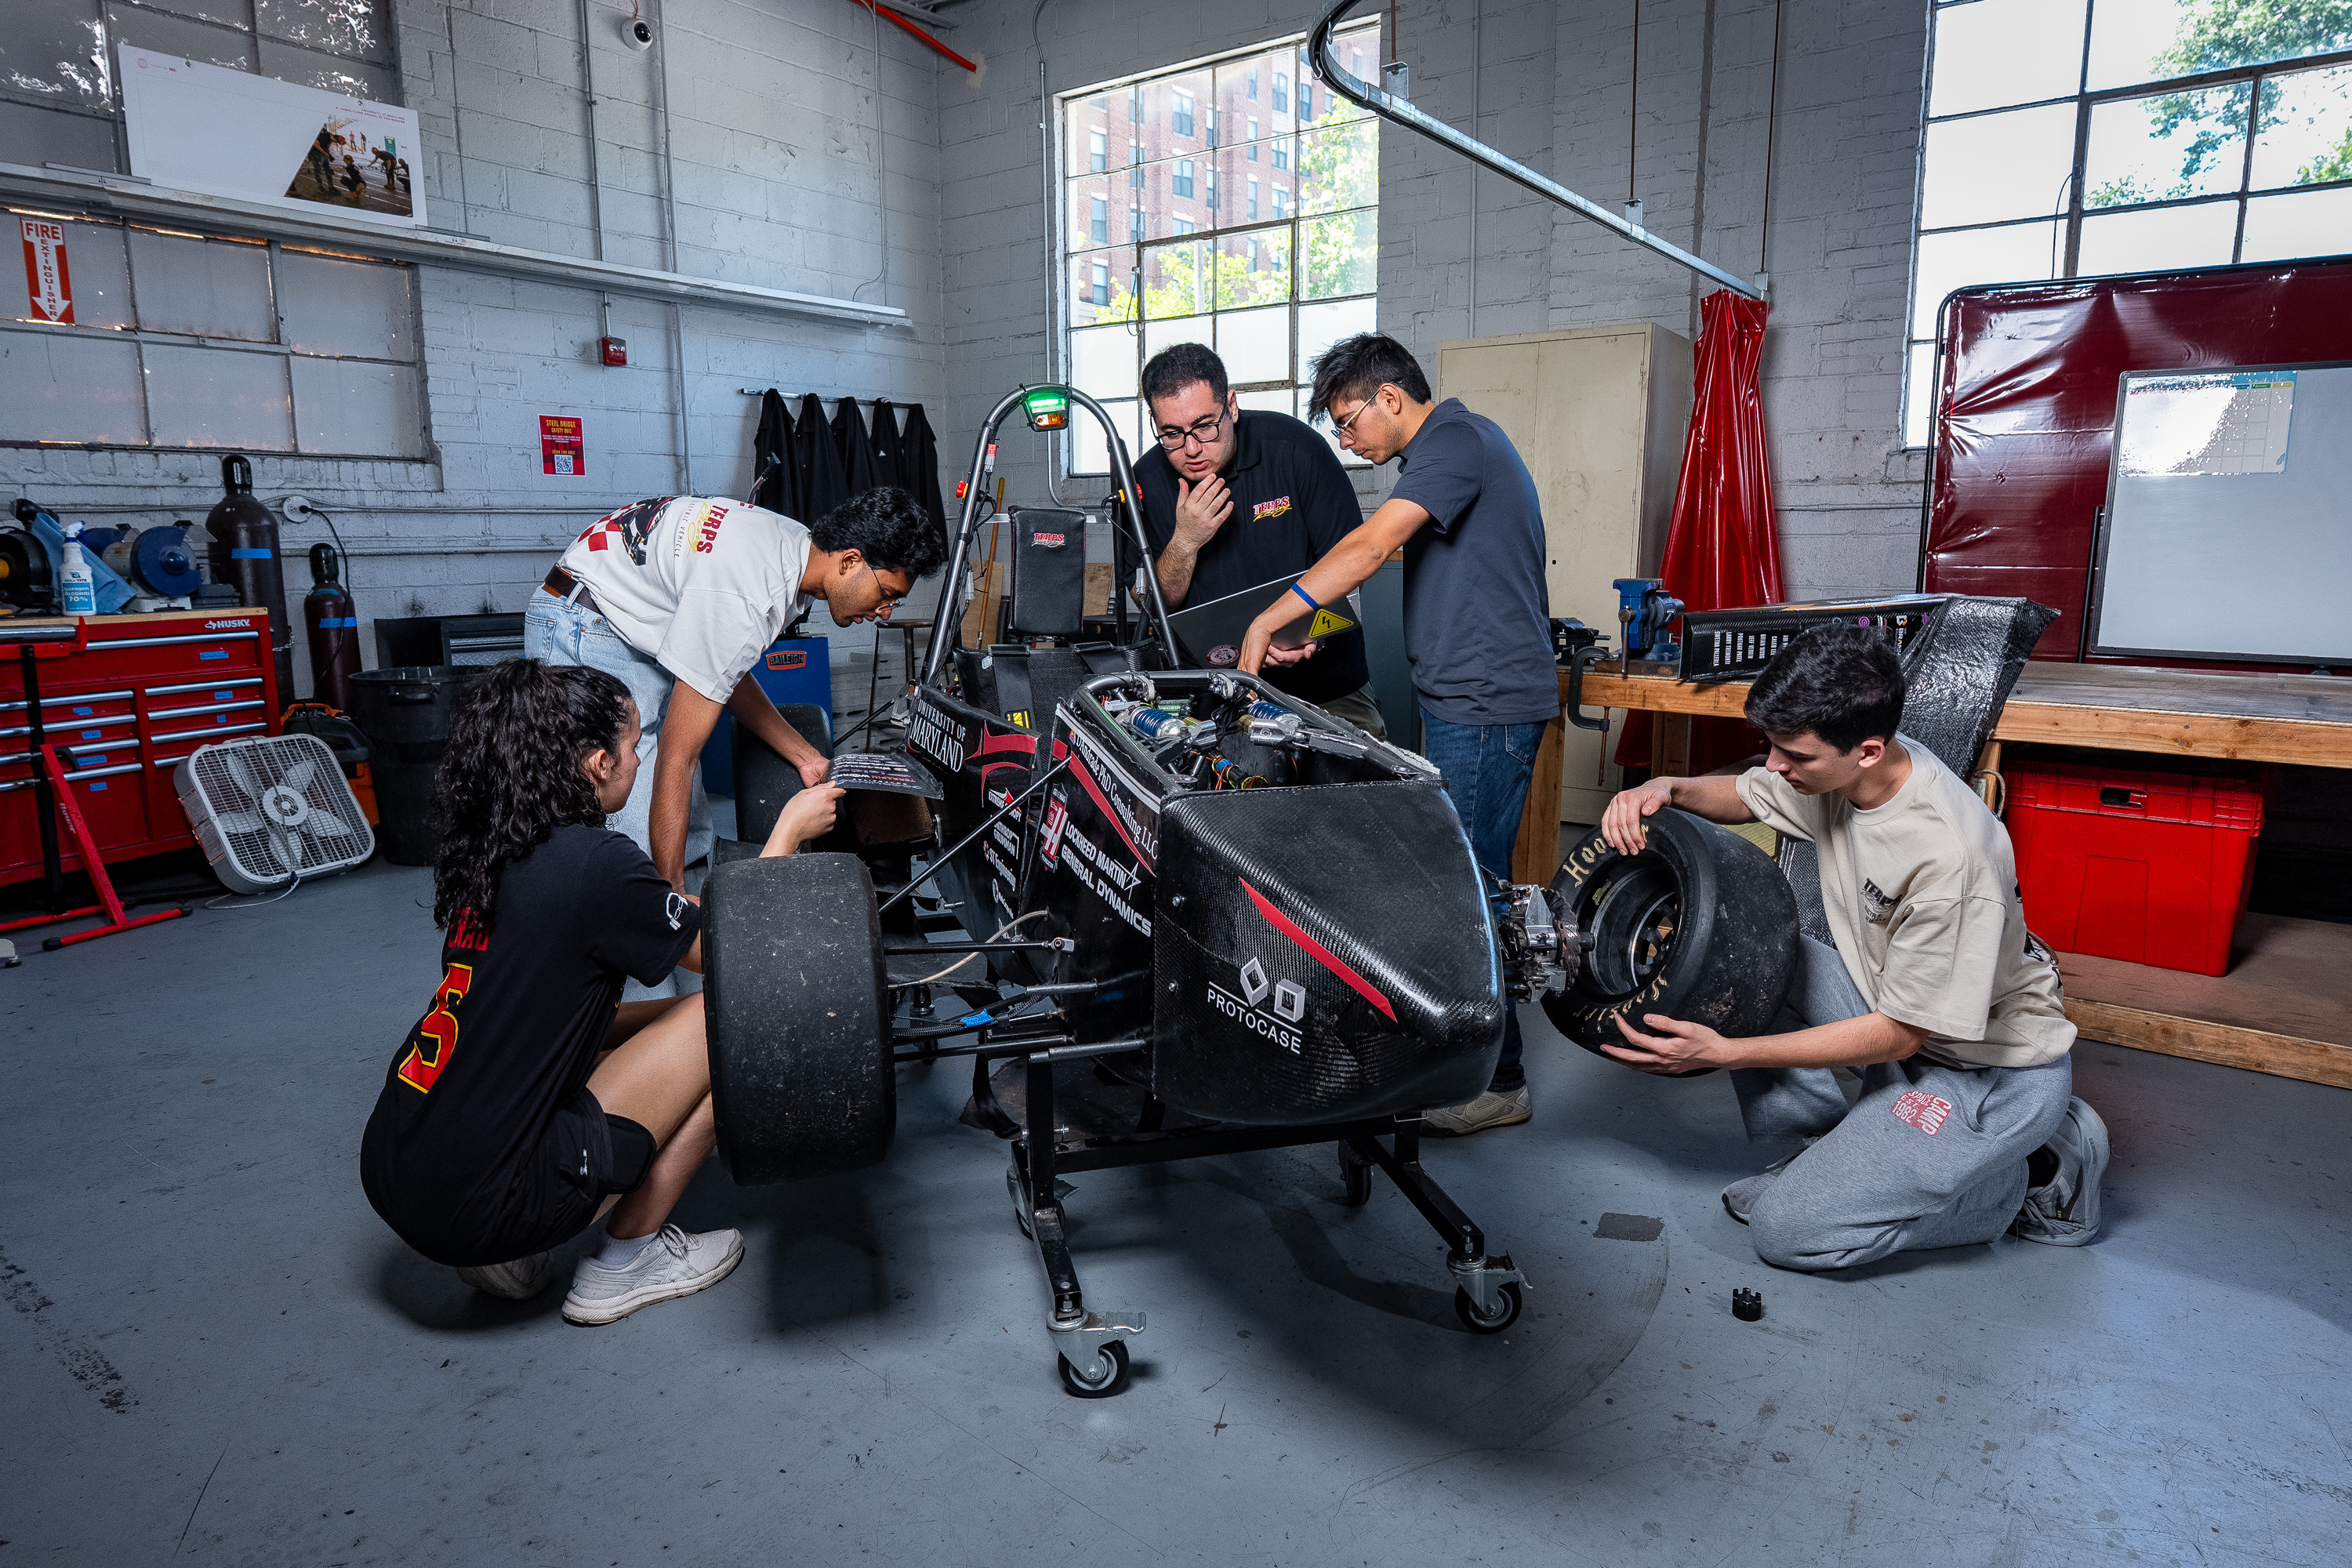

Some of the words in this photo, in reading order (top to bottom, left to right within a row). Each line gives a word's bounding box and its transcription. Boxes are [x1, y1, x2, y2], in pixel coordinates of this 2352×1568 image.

[25, 222, 60, 240] FIRE
[40, 238, 58, 317] EXTINGUISHER
[1253, 495, 1290, 515] TERPS
[673, 526, 686, 557] VEHICLE
[696, 504, 730, 554] TERPS
[1033, 532, 1065, 542] TERPS
[216, 619, 251, 628] HUSKY
[769, 654, 804, 665] BAILEIGH
[917, 699, 956, 735] UNIVERSITY
[956, 724, 966, 742] OF
[909, 714, 964, 773] MARYLAND
[1098, 764, 1112, 793] PhD
[1110, 782, 1142, 844] Consulting
[1141, 826, 1159, 860] LLC
[993, 828, 1016, 857] GRUMMAN
[1065, 821, 1097, 862] LOCKHEED
[1095, 850, 1127, 890] MARTIN
[989, 848, 996, 866] ST
[995, 852, 1016, 892] Engineering
[1061, 844, 1094, 890] GENERAL
[1096, 878, 1152, 938] DYNAMICS
[1207, 988, 1301, 1055] PROTOCASE
[1892, 1100, 1918, 1123] 1982
[1907, 1091, 1934, 1106] SPACE
[1917, 1097, 1952, 1135] CAMP
